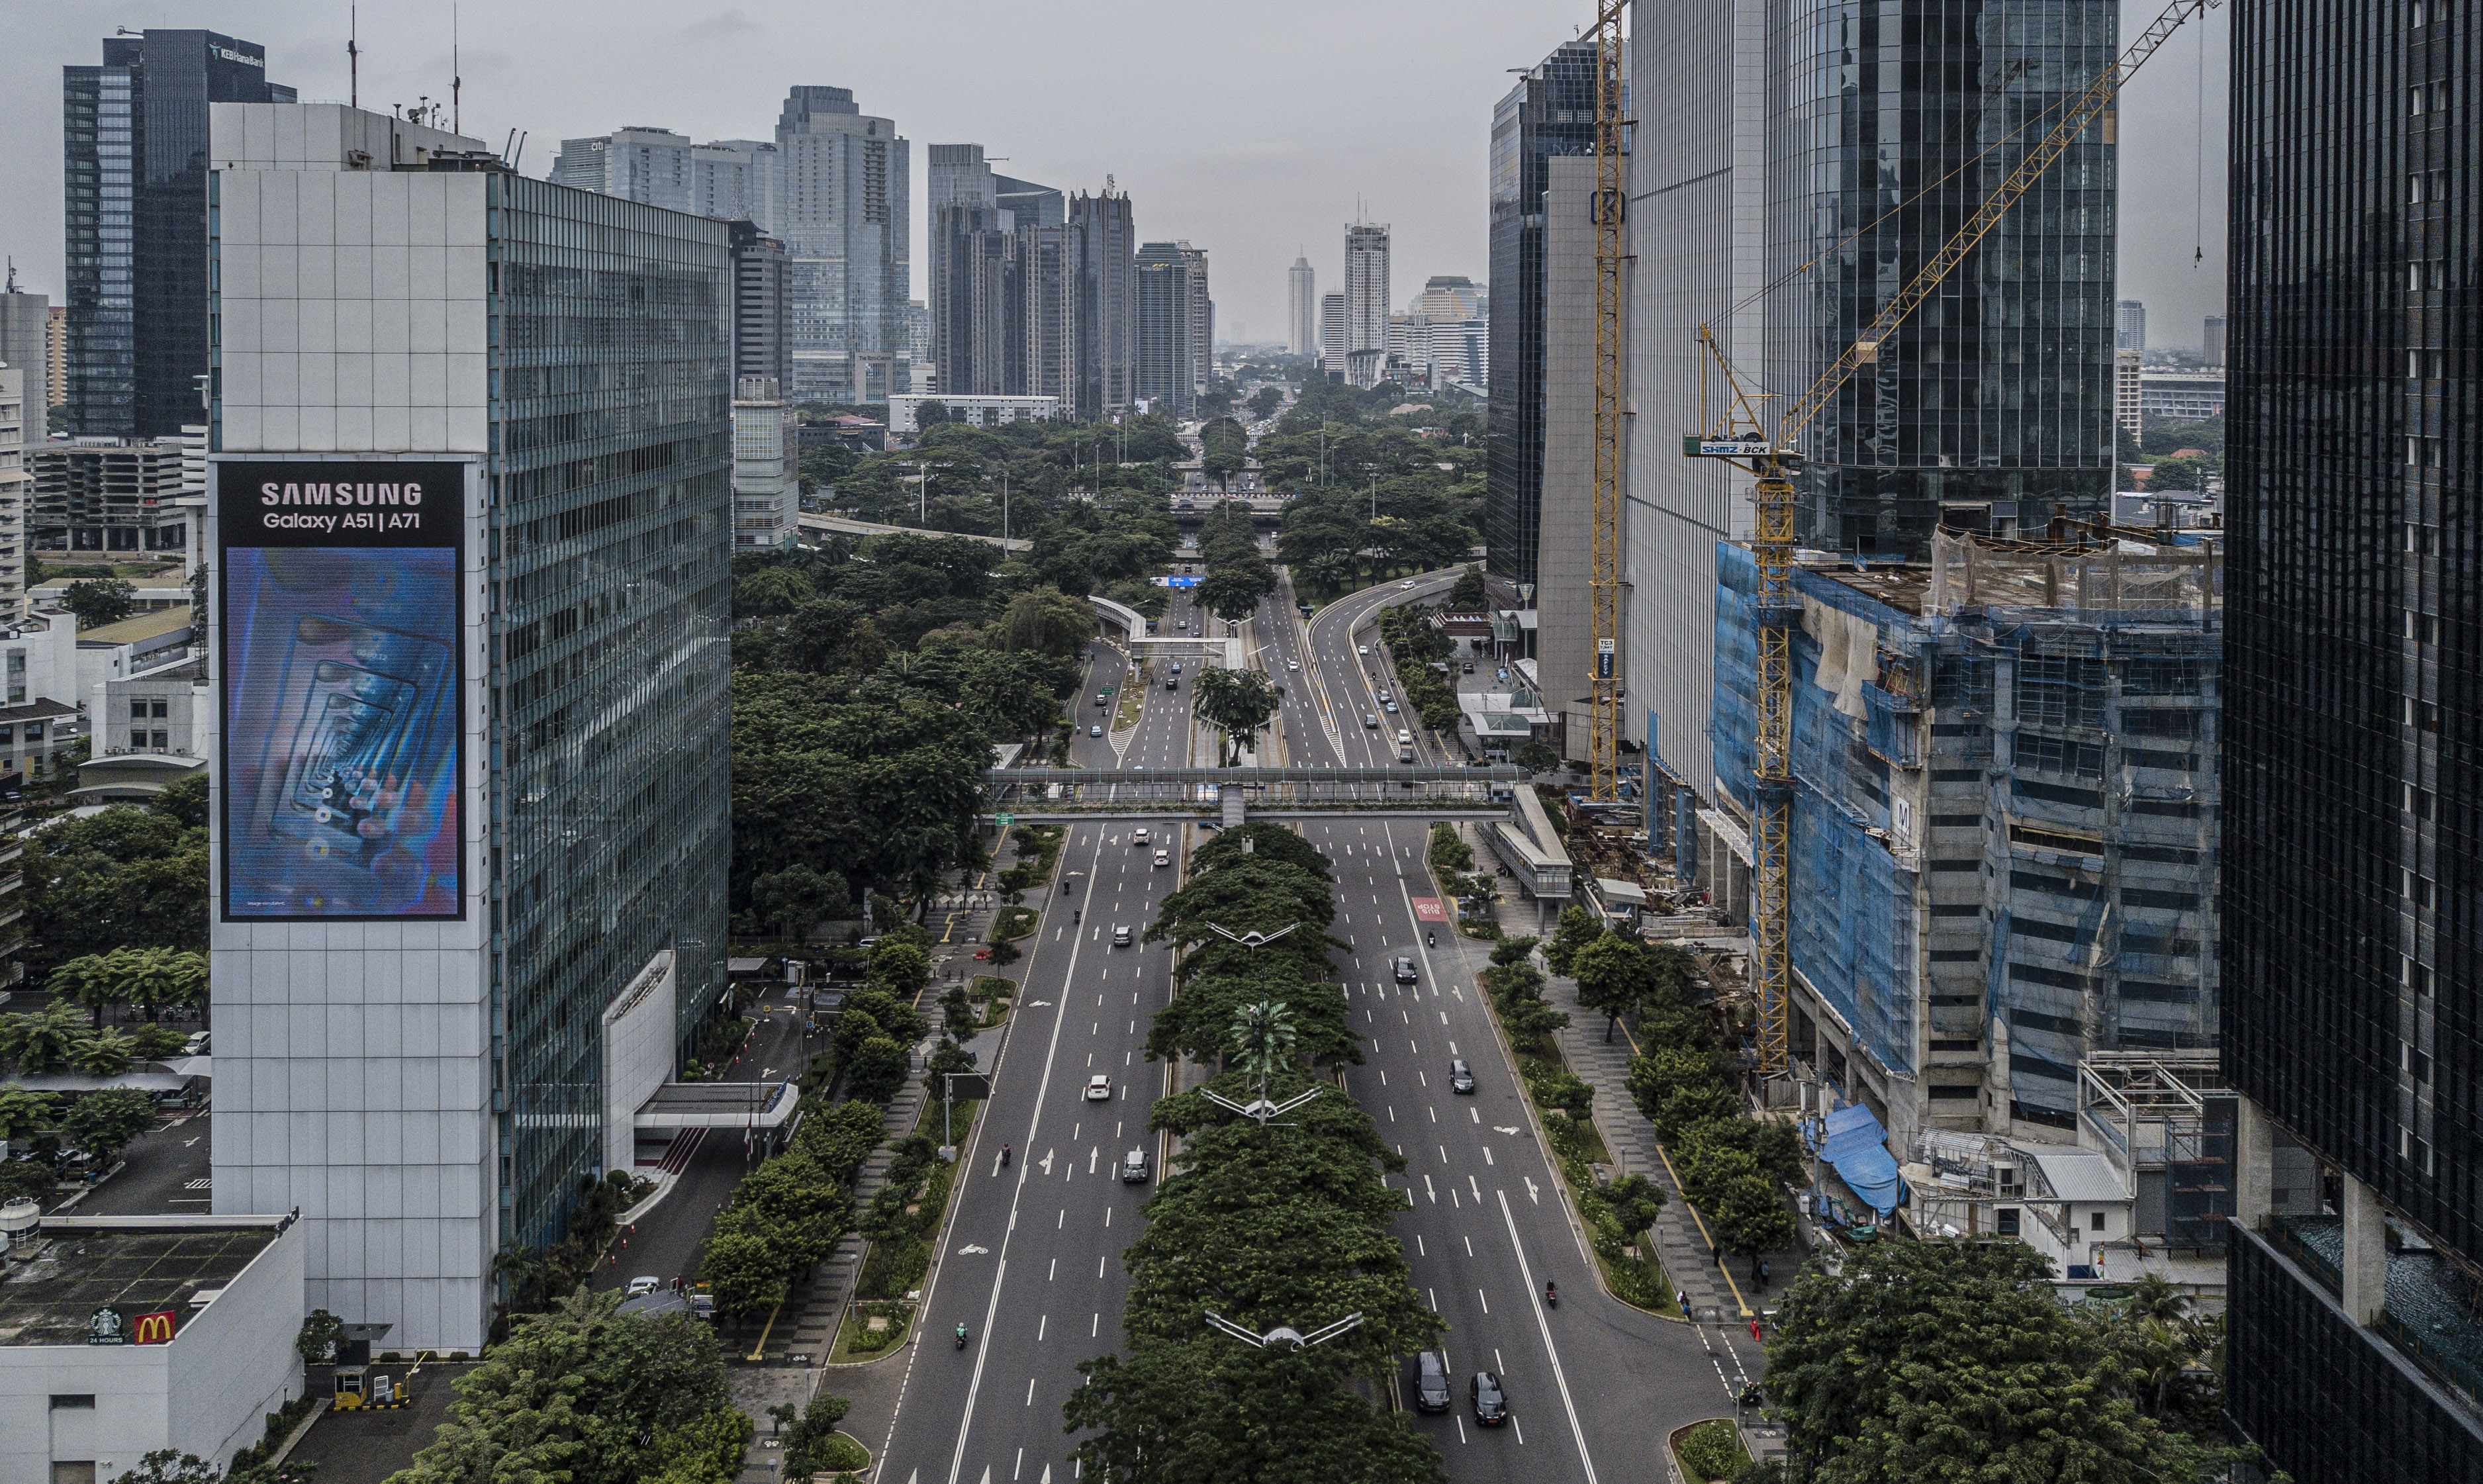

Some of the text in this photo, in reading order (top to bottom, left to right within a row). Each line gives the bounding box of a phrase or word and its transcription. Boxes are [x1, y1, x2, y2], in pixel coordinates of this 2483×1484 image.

[221, 48, 263, 68] KEB Hana Bank
[591, 141, 603, 151] citi
[261, 483, 422, 505] SAMSUNG
[263, 513, 337, 533] Galaxy
[342, 513, 373, 528] A51
[388, 513, 420, 528] A71
